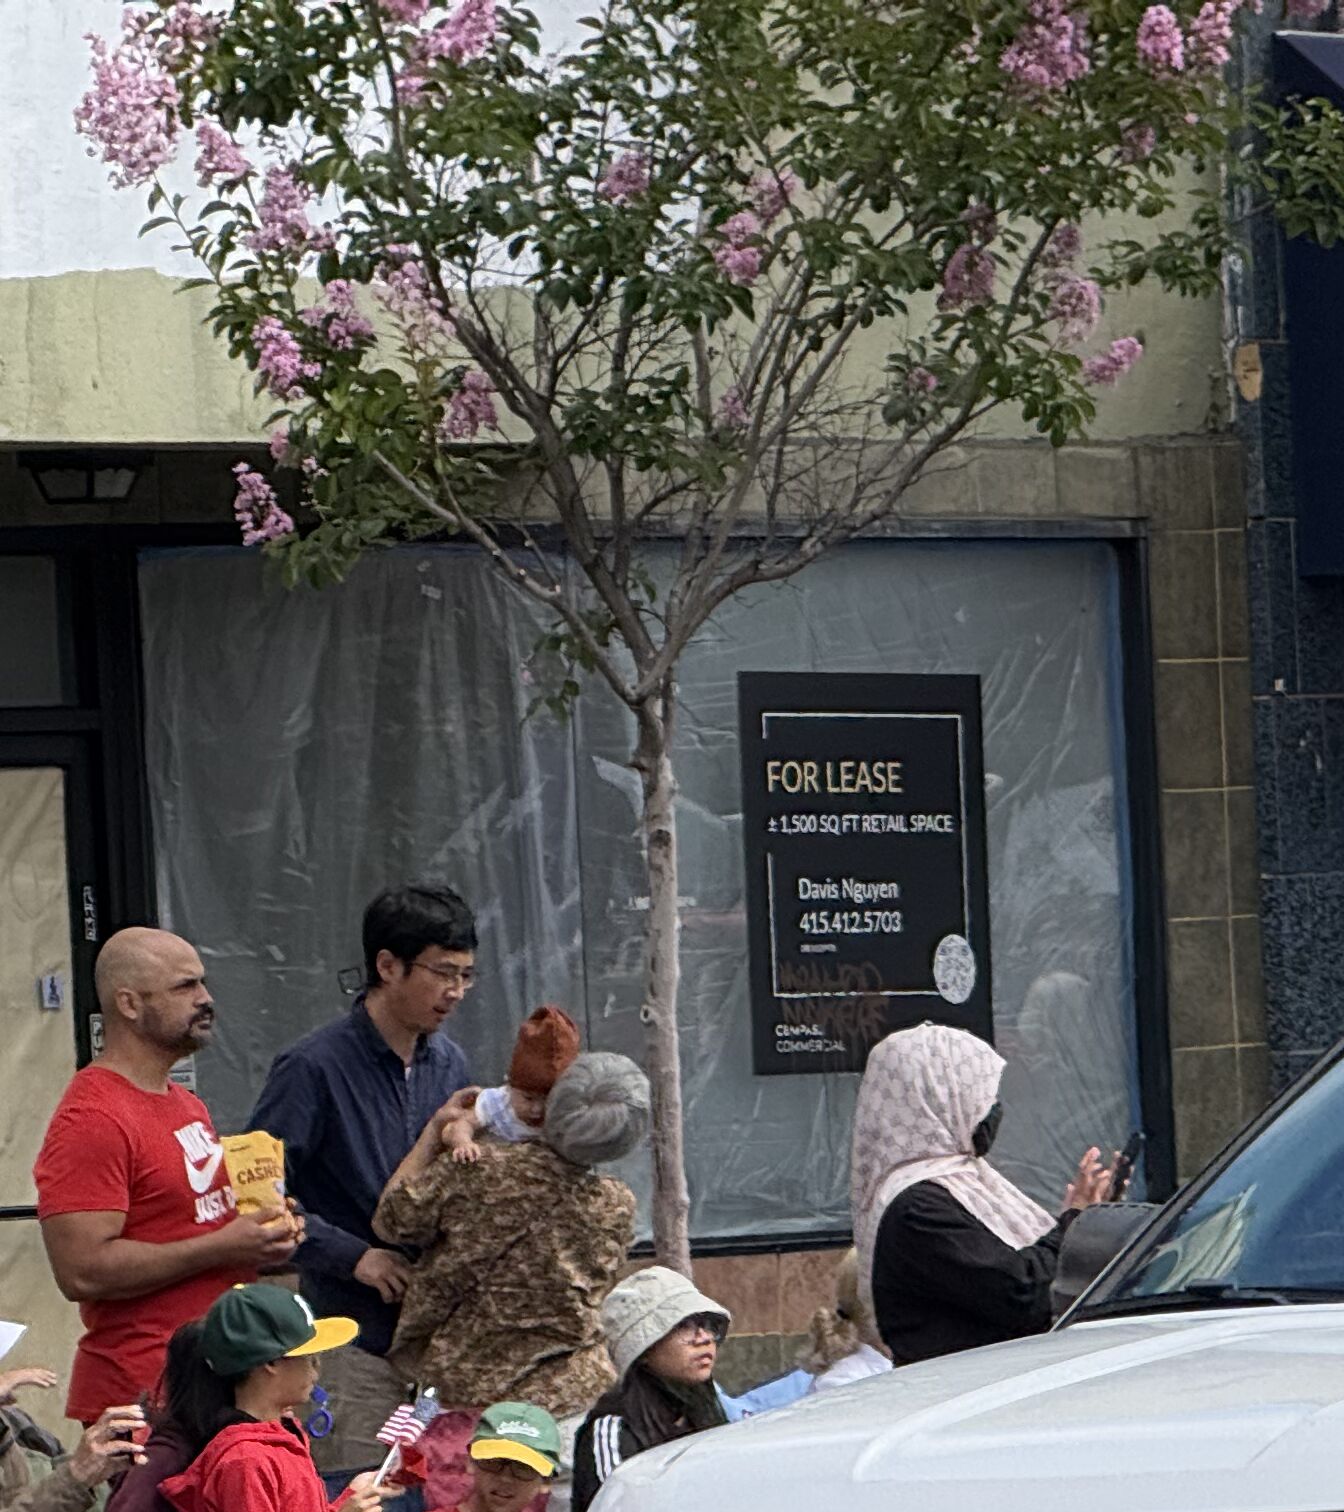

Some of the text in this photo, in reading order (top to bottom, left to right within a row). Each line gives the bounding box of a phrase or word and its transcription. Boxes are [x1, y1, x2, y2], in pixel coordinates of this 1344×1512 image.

[767, 761, 904, 794] FOR LEASE
[819, 815, 839, 835] SQ
[842, 815, 860, 834] FT
[862, 815, 908, 834] RETAIL
[910, 815, 954, 833] SPACE
[799, 877, 899, 902] Davis Nguyen
[800, 911, 902, 934] 415.412.5703
